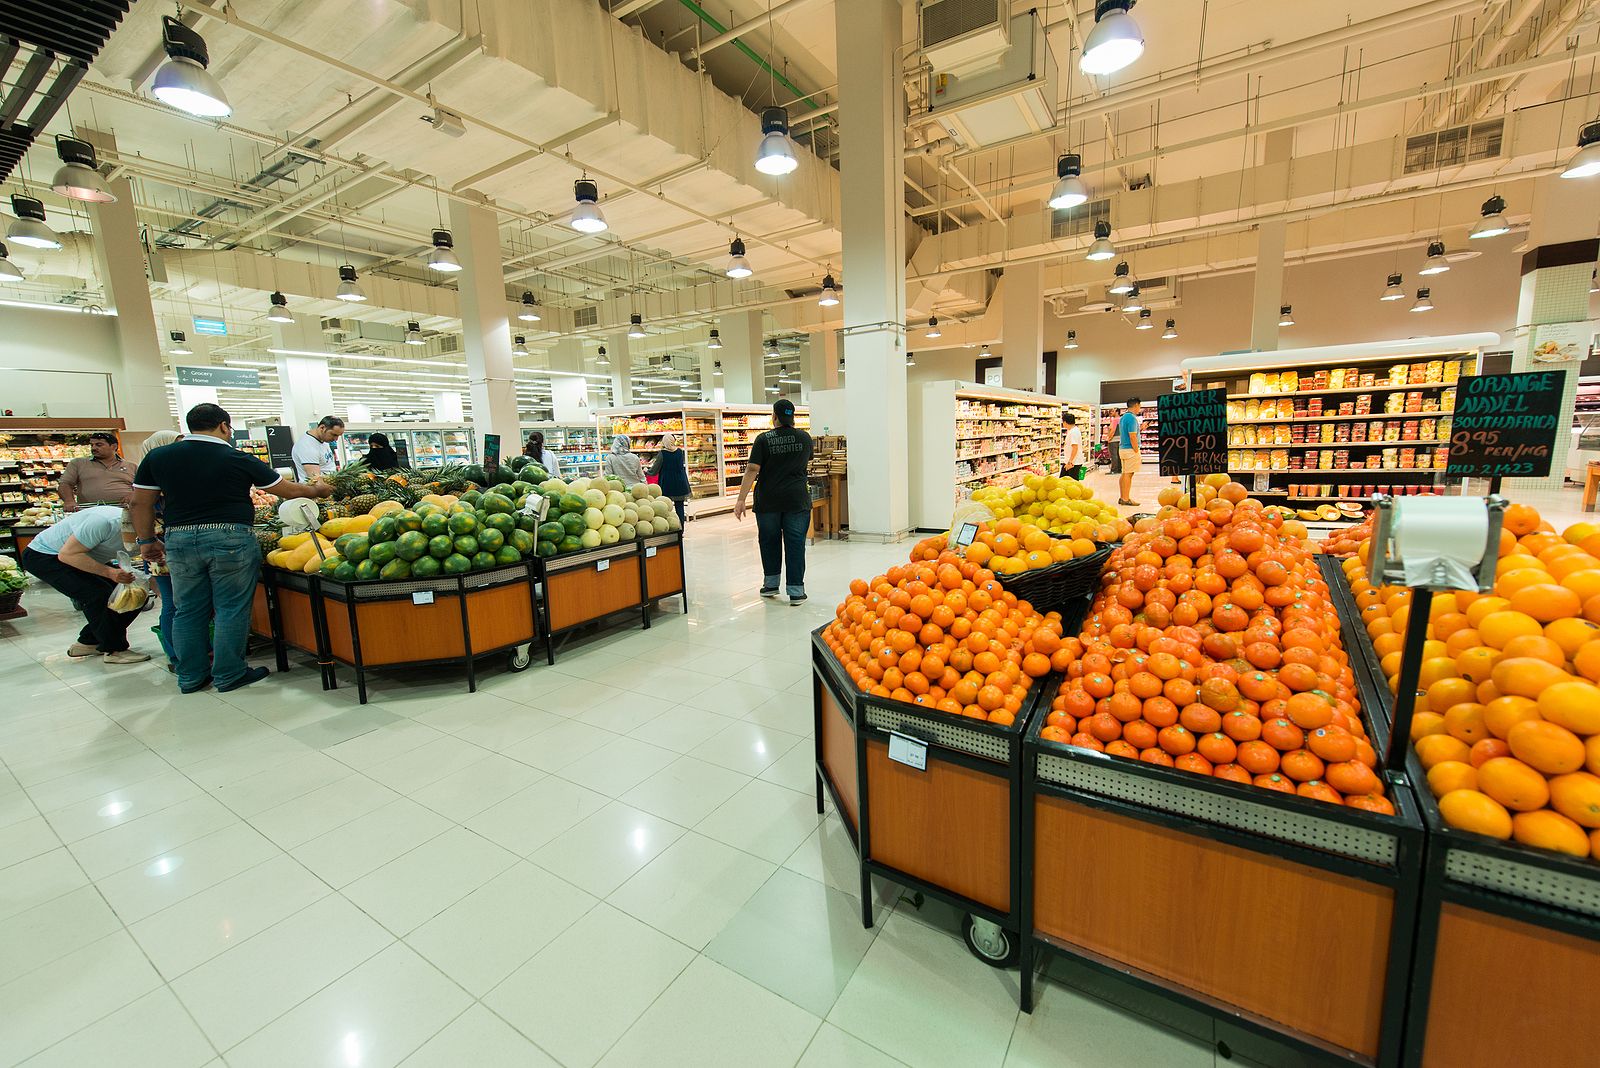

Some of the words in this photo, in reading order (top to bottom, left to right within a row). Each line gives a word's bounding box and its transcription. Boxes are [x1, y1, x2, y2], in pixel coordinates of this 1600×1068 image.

[1469, 373, 1554, 394] ORANGE
[1159, 390, 1218, 408] AFOURER
[1456, 394, 1529, 414] NAVEL
[1159, 404, 1227, 422] MANDARIN
[268, 428, 275, 436] 2
[1160, 418, 1228, 436] AUSTRALIA
